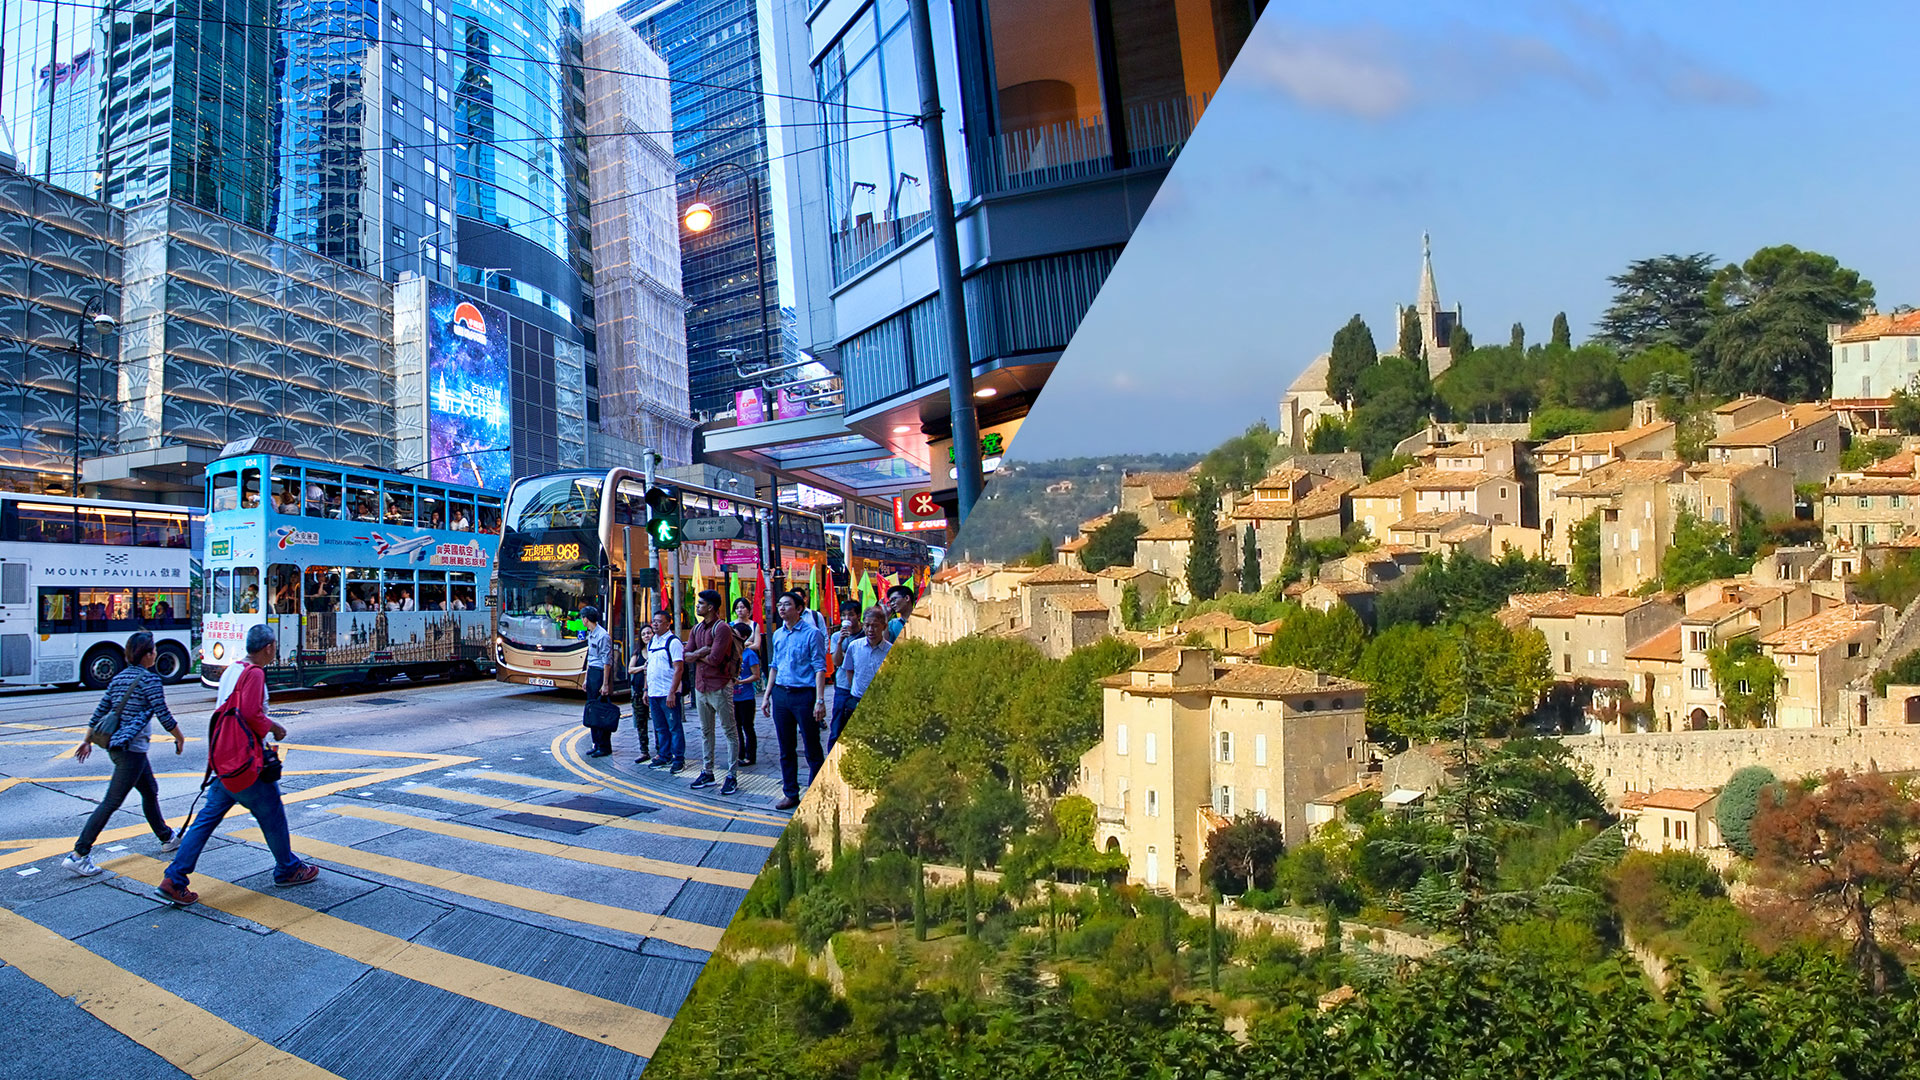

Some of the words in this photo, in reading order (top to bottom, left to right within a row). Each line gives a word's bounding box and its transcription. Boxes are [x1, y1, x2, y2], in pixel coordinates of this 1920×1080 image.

[245, 459, 257, 467] 104
[523, 544, 554, 556] 元朗西
[556, 543, 580, 560] 968
[45, 568, 98, 576] MOUNT
[103, 568, 157, 577] PAVILIA
